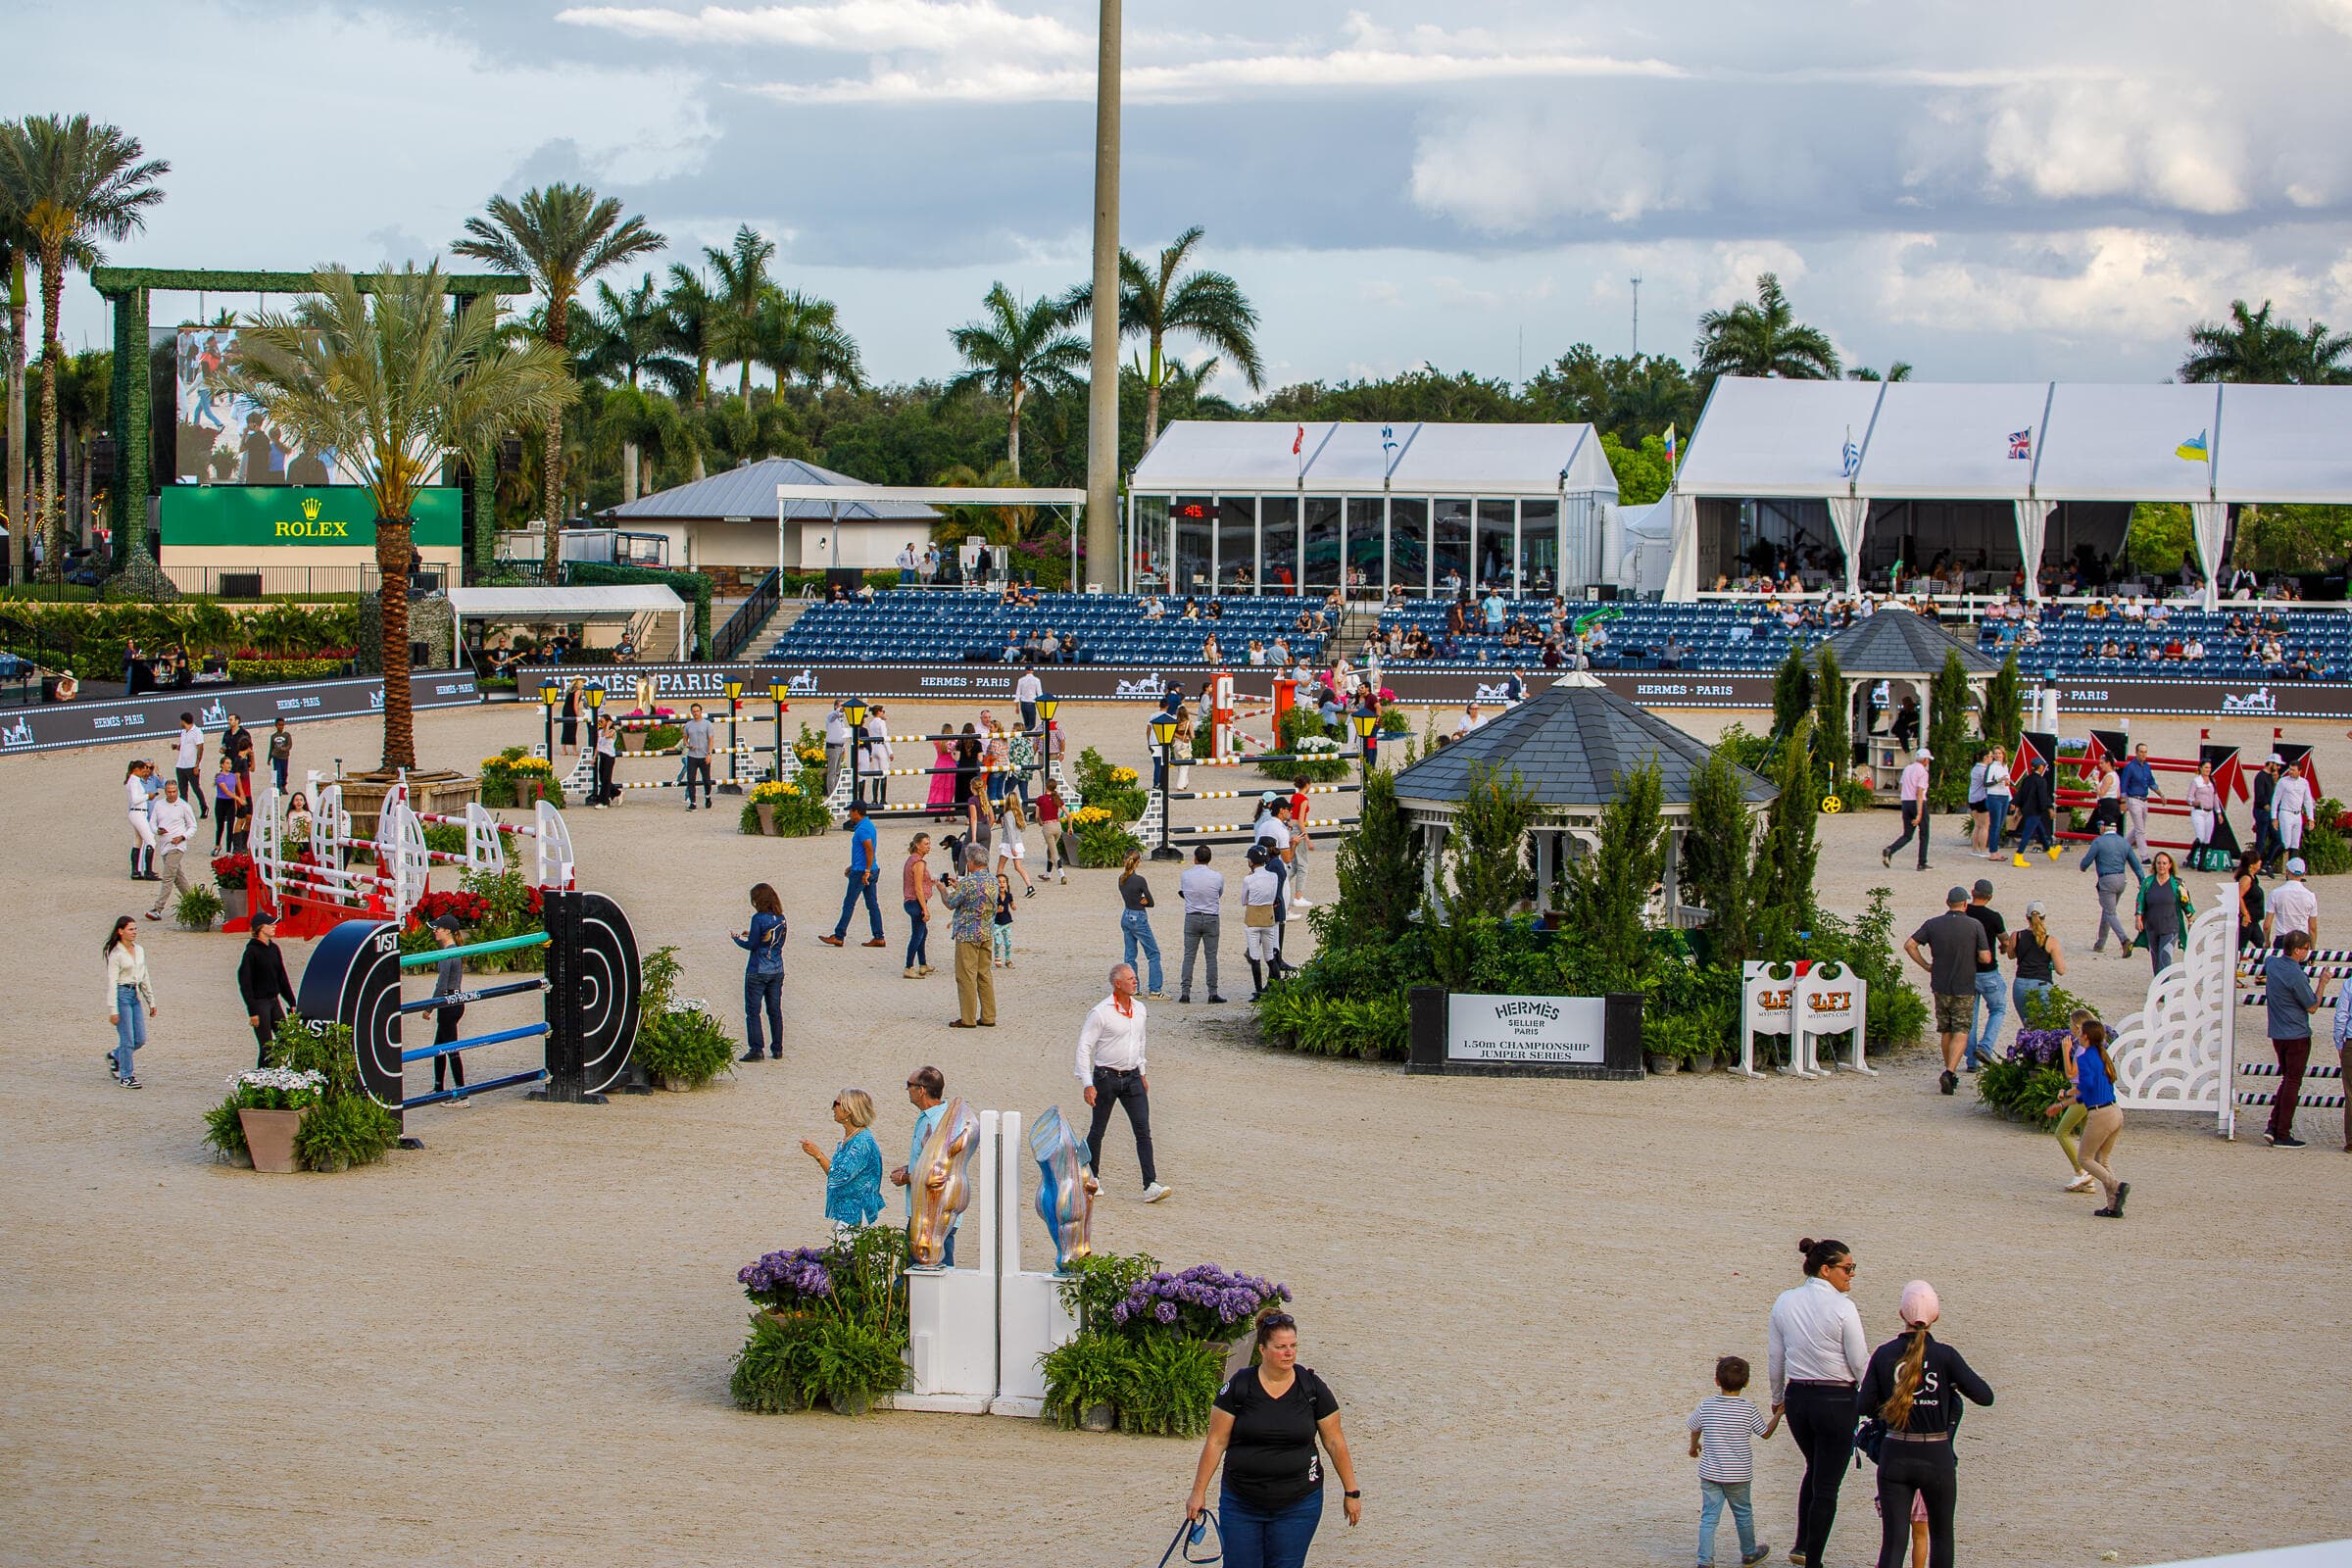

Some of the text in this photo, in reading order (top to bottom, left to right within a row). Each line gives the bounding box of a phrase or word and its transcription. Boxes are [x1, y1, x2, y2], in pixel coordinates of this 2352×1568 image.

[275, 522, 348, 537] ROLEX
[658, 673, 724, 691] PARIS
[976, 677, 1010, 687] PARIS
[1696, 685, 1733, 695] PARIS
[2071, 690, 2109, 701] PARIS
[123, 713, 145, 726] PARIS
[1763, 990, 1792, 1008] LF
[1812, 992, 1851, 1009] LFI
[1494, 1001, 1560, 1020] HERMÈS
[1508, 1019, 1545, 1028] SELLIER
[1463, 1040, 1591, 1052] 1.50m CHAMPIONSHIP
[1480, 1050, 1572, 1060] JUMPER SERIES
